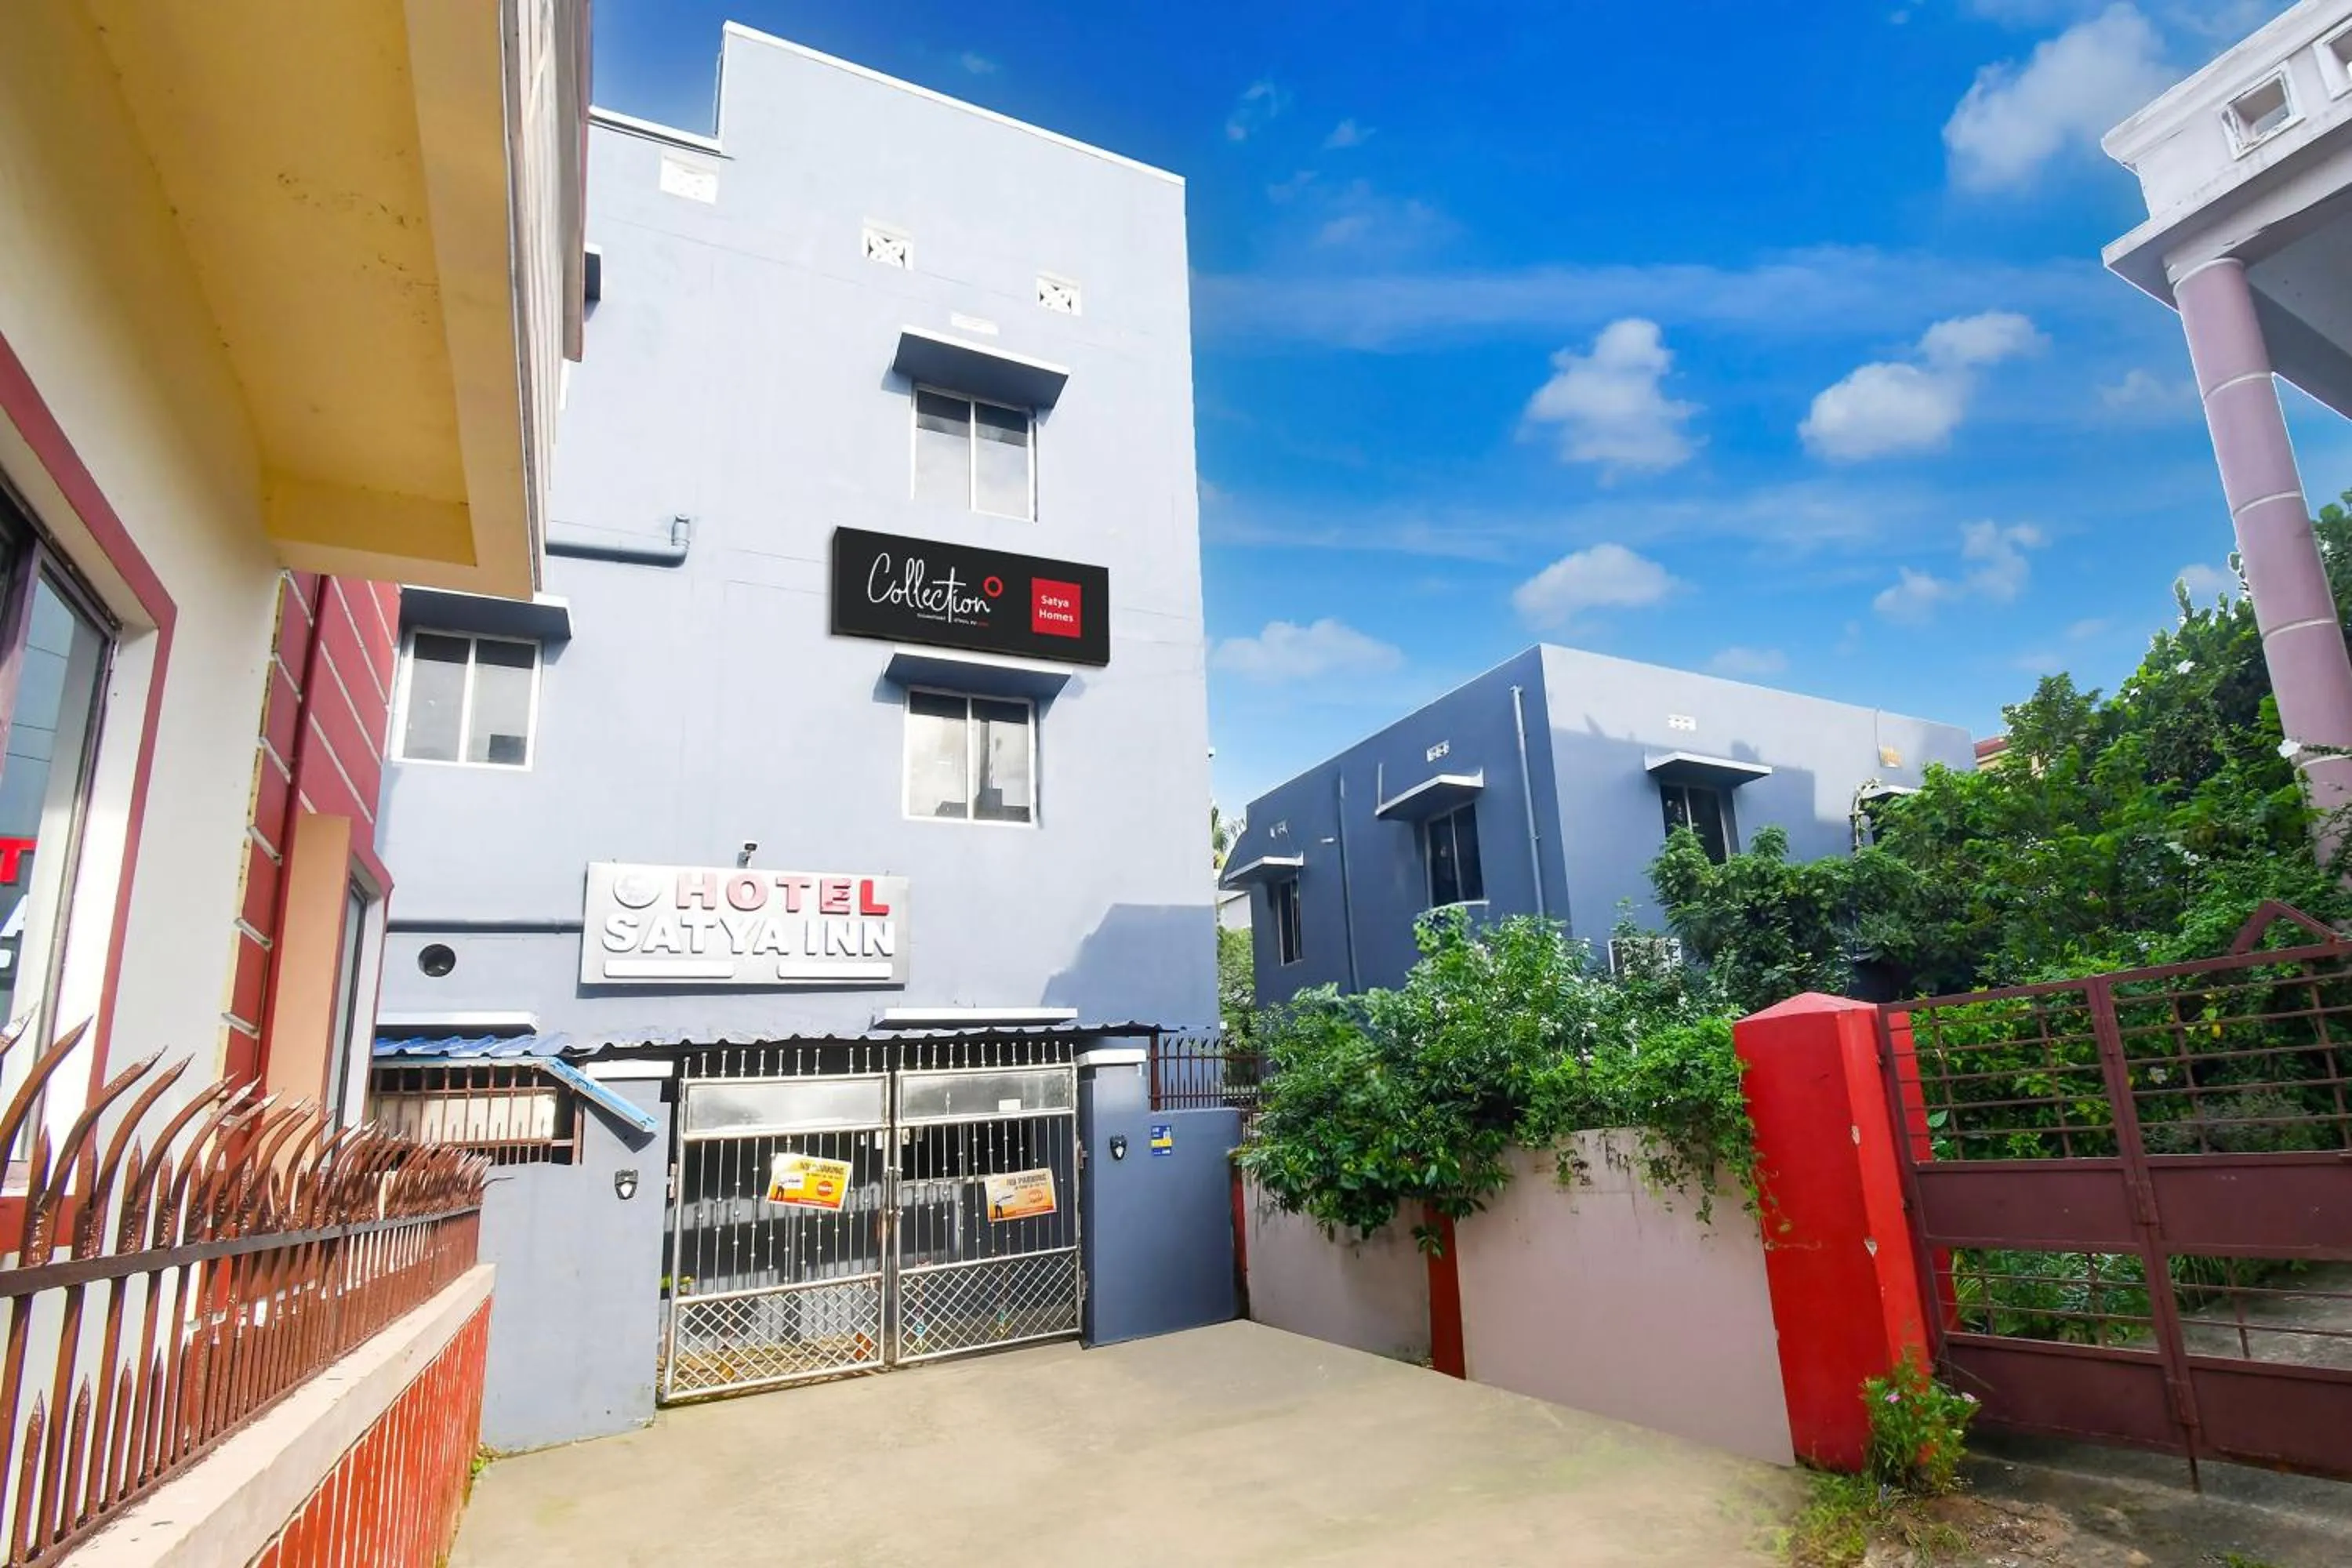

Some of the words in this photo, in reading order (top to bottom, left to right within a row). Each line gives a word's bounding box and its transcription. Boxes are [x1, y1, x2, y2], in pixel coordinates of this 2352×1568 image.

[867, 552, 991, 623] Collection
[1040, 594, 1069, 609] Satya
[1039, 608, 1074, 623] Homes
[675, 873, 891, 916] HOTEL
[602, 913, 789, 956] SATYA
[805, 920, 896, 956] INN
